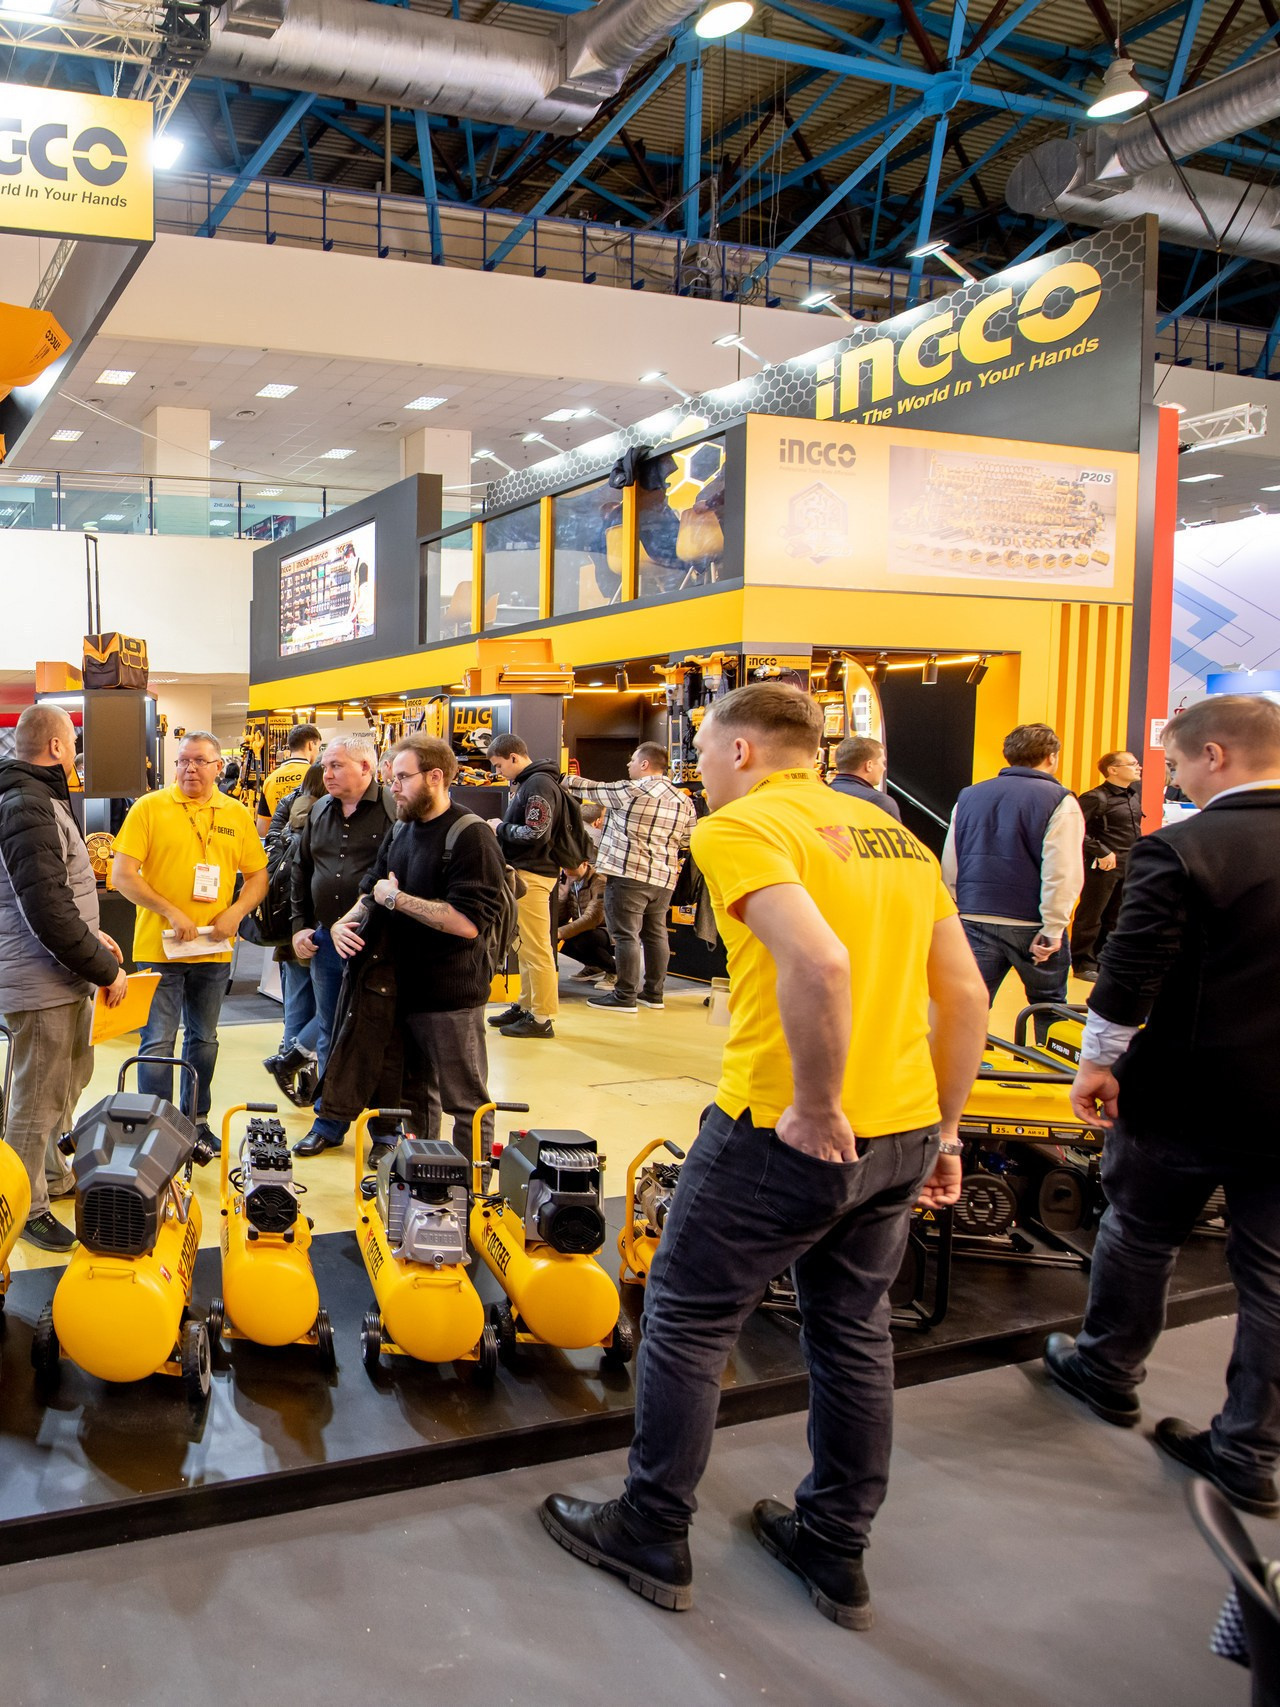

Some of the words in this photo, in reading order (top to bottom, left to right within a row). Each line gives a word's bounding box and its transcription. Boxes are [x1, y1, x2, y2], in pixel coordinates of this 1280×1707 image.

[25, 185, 39, 198] In
[44, 187, 78, 203] Your
[82, 191, 128, 208] Hands
[862, 406, 893, 425] The
[897, 385, 950, 414] World
[954, 380, 972, 396] In
[978, 364, 1025, 388] Your
[1029, 336, 1100, 373] Hands
[1079, 471, 1113, 485] P20S
[457, 706, 491, 724] ING
[217, 826, 236, 838] DENZEL
[847, 825, 931, 864] DENZEL
[369, 1237, 385, 1281] DENZEL
[487, 1232, 512, 1278] DENZEL
